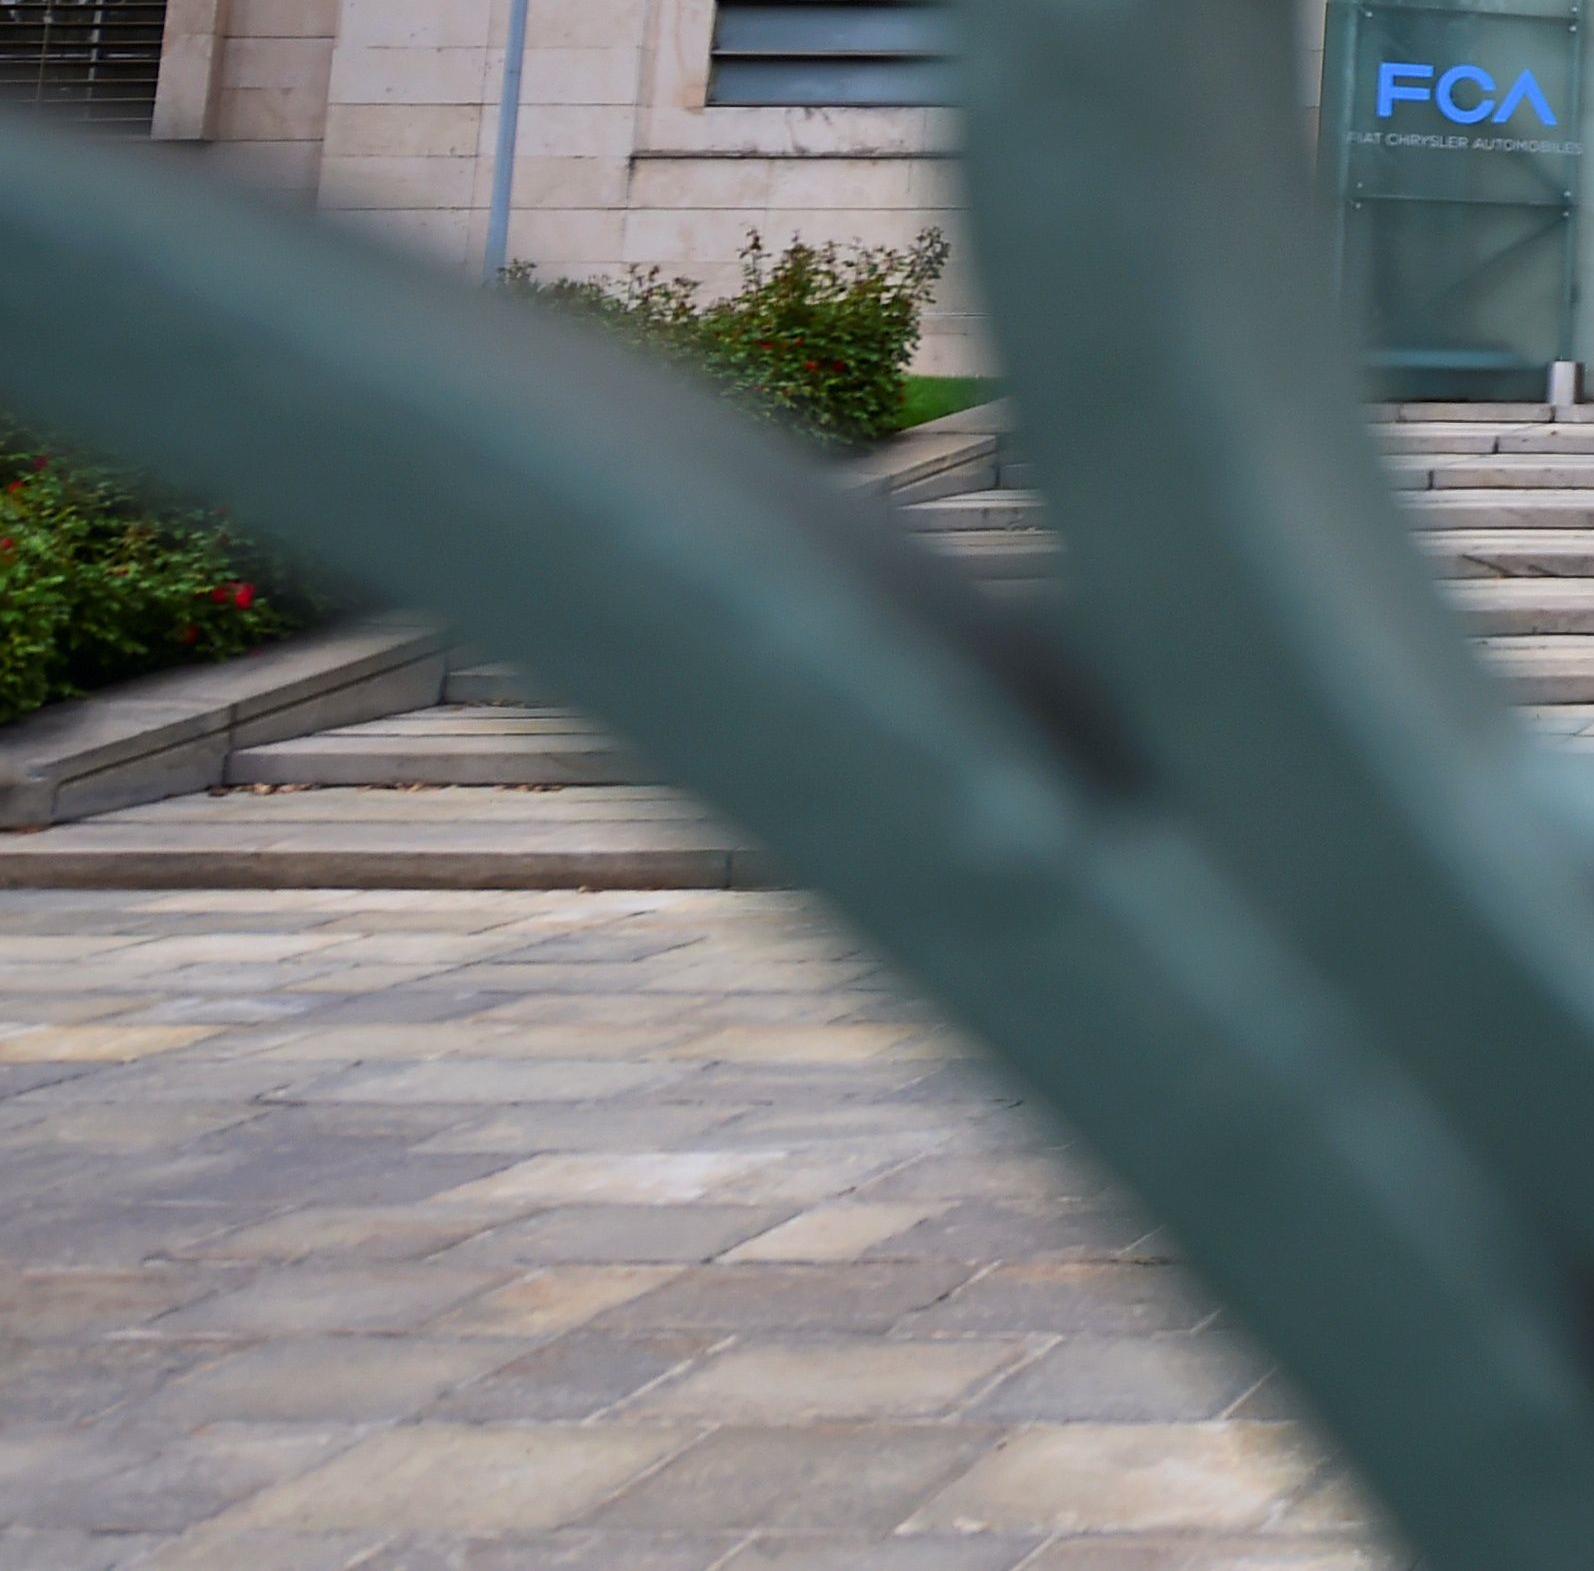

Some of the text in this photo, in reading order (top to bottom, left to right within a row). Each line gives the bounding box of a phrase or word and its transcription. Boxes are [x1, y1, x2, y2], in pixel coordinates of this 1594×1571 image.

[1375, 61, 1559, 127] FCA
[1385, 132, 1470, 150] CHRYSLER
[1473, 136, 1585, 156] AUTOMOBILES
